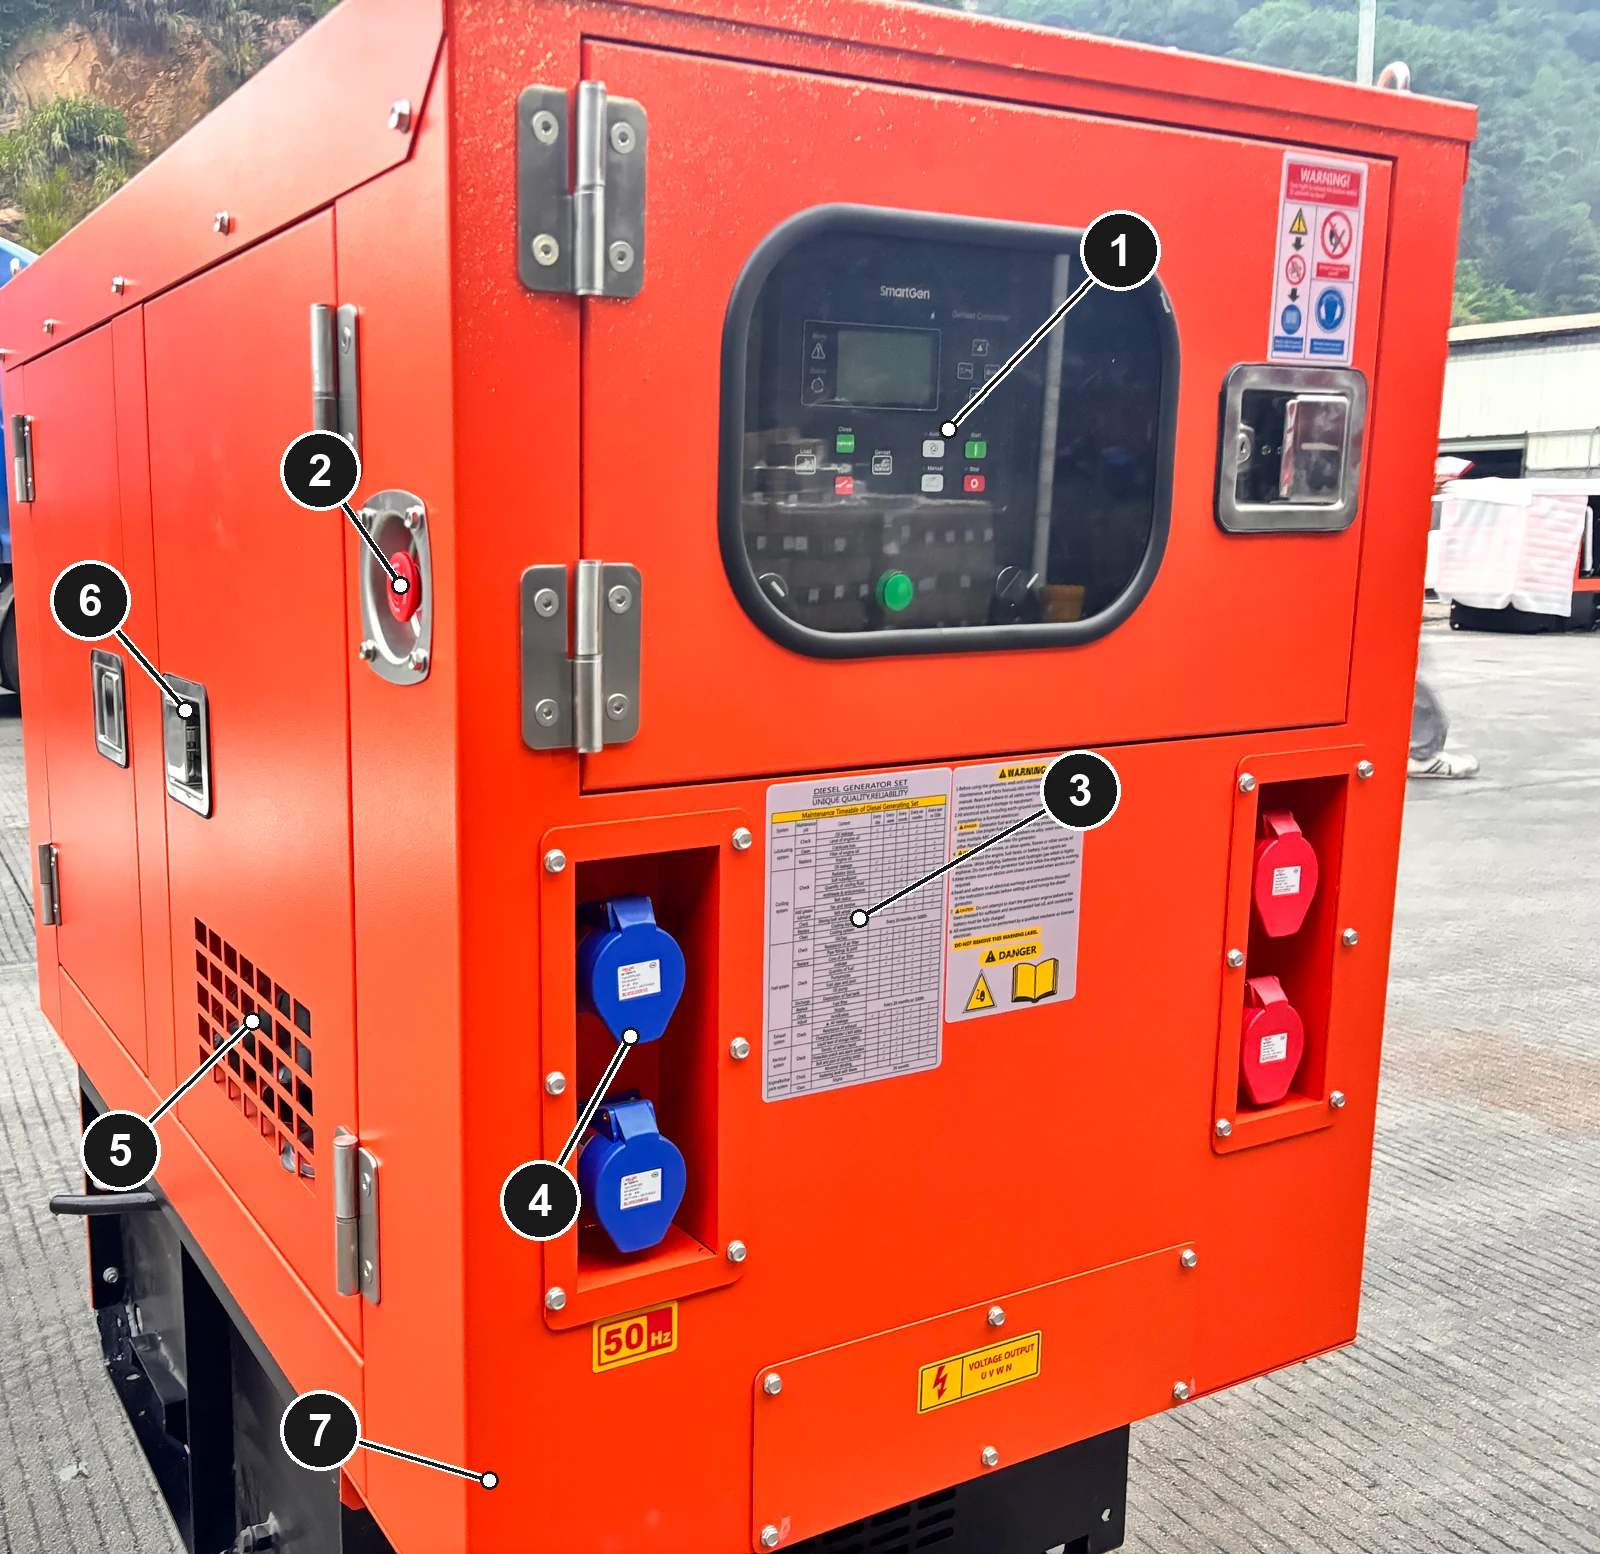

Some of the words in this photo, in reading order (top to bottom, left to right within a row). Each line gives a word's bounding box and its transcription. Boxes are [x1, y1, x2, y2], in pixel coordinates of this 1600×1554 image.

[1301, 168, 1351, 188] WARNING!
[880, 286, 930, 300] SmartGen
[813, 785, 840, 795] DIESEL
[843, 780, 891, 792] GENERATOR
[893, 778, 908, 786] SET
[801, 808, 834, 819] Maintenance
[836, 806, 858, 815] Timeable
[866, 803, 881, 812] Diesel
[882, 800, 909, 810] Generating
[910, 799, 918, 807] Set
[812, 796, 839, 806] UNIQUE
[998, 946, 1036, 959] DANGER
[604, 1323, 644, 1356] 50
[651, 1330, 672, 1347] Hz
[969, 1353, 1003, 1371] VOLTAGE
[1004, 1343, 1035, 1360] OUTPUT
[981, 1371, 987, 1380] U
[989, 1368, 995, 1377] V
[996, 1366, 1004, 1375] W
[1005, 1363, 1012, 1372] N
